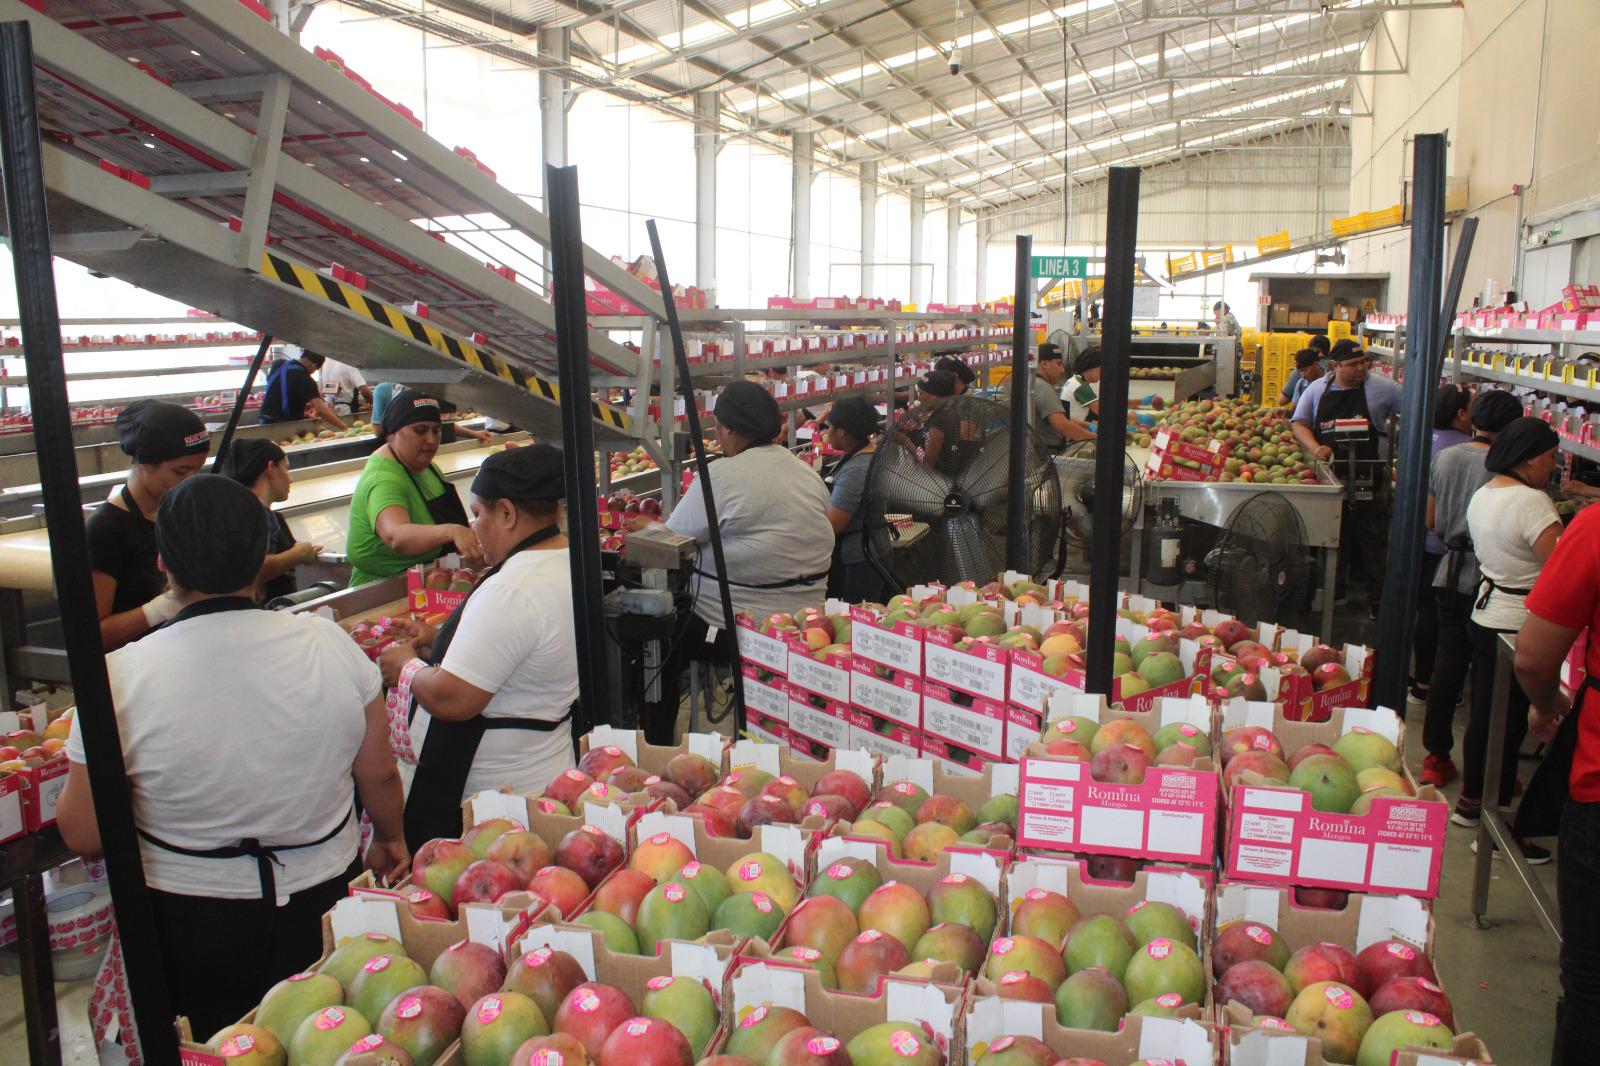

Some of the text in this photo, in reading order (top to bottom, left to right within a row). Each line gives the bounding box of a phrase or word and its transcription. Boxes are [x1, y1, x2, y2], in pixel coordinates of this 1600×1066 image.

[1039, 258, 1079, 276] LINEA 3
[1184, 446, 1208, 458] Romina
[1014, 652, 1037, 668] Romina
[1320, 688, 1352, 708] Romina
[1088, 785, 1141, 803] Romina
[1100, 799, 1128, 808] Mangos
[1309, 816, 1365, 836] Romina
[1377, 830, 1397, 838] STORED
[1322, 831, 1351, 841] Mangos
